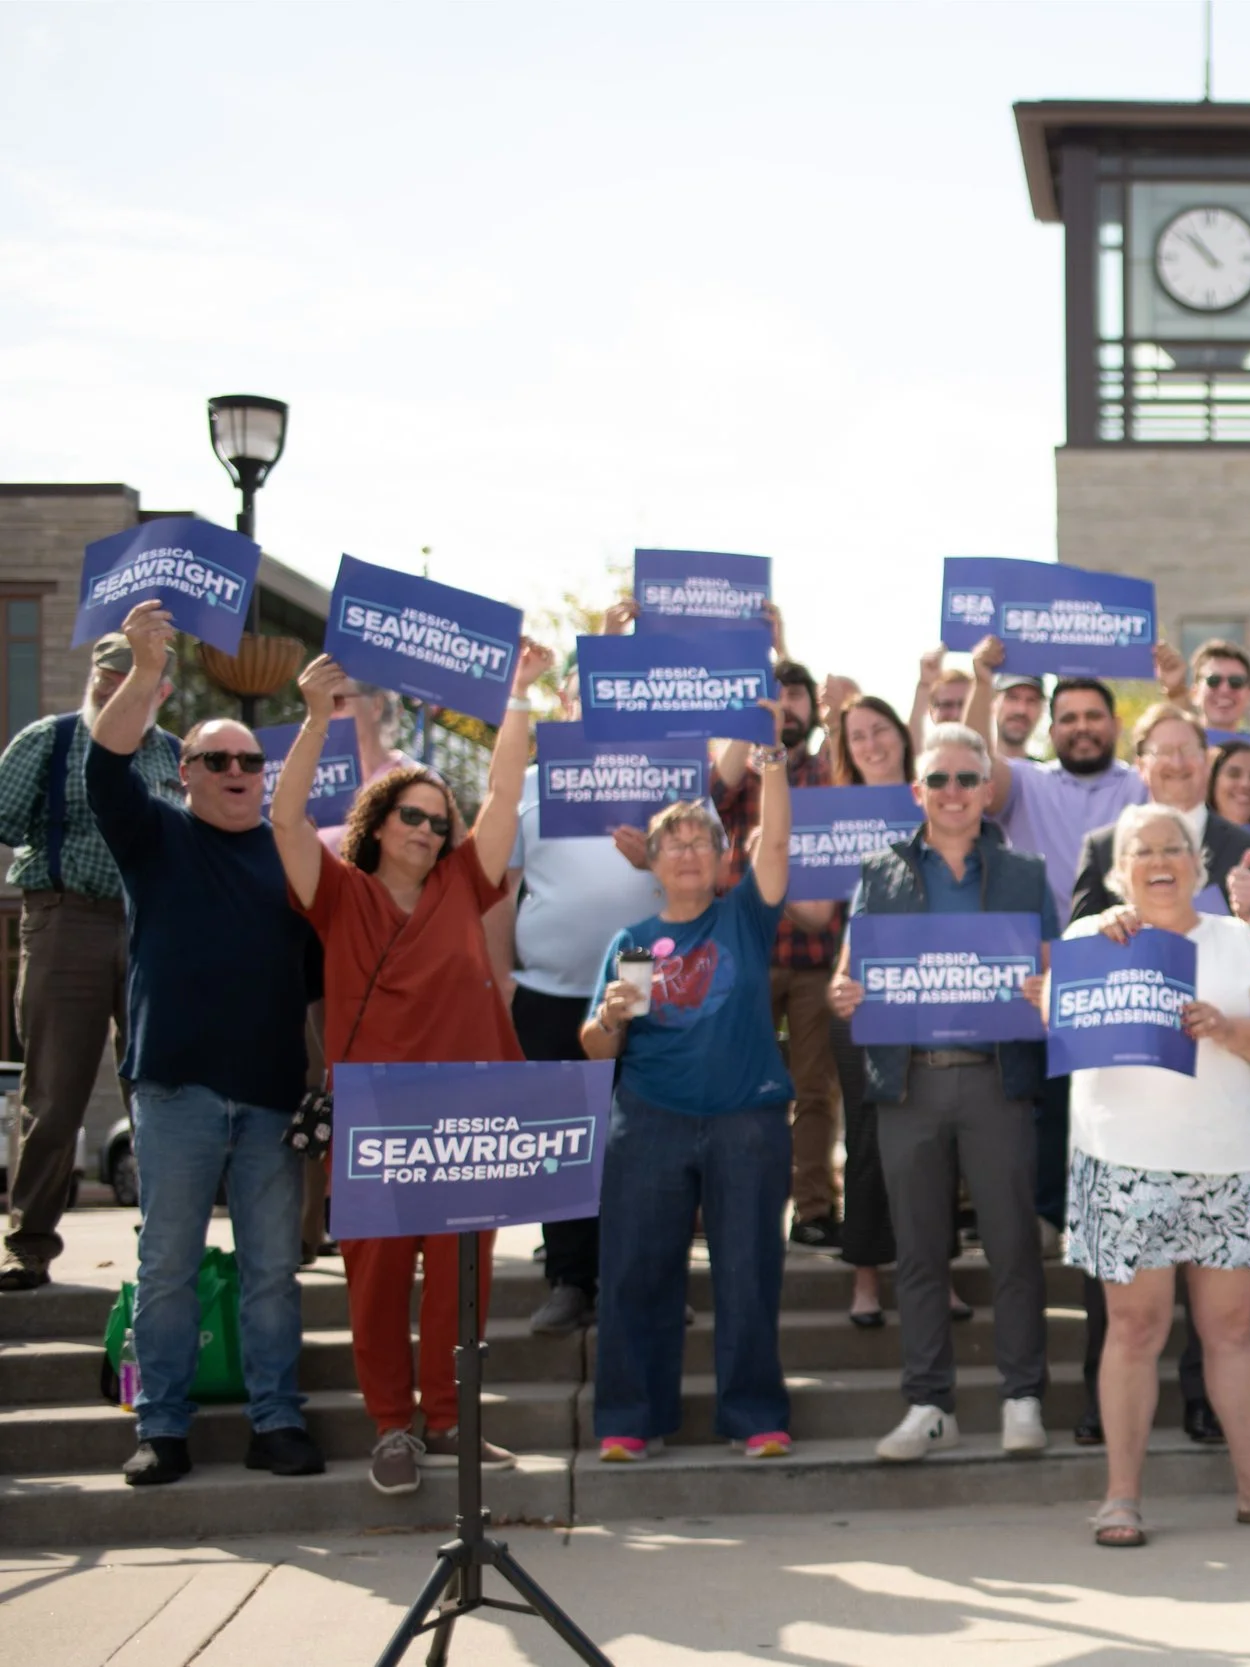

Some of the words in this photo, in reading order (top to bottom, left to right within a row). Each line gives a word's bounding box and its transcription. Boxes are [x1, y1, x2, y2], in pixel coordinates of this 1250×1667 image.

[134, 547, 195, 565] JESSICA
[92, 558, 240, 601] SEAWRIGHT
[685, 576, 731, 589] JESSICA
[103, 585, 128, 605] FOR
[130, 575, 206, 599] ASSEMBLY
[645, 585, 765, 611] SEAWRIGHT
[1052, 600, 1103, 614] JESSICA
[401, 607, 461, 634] JESSICA
[1005, 609, 1146, 636] SEAWRIGHT
[346, 605, 507, 670] SEAWRIGHT
[1021, 631, 1049, 643] FOR
[1051, 631, 1115, 646] ASSEMBLY
[362, 630, 395, 649] FOR
[395, 641, 471, 674] ASSEMBLY
[648, 666, 709, 681] JESSICA
[596, 677, 761, 701] SEAWRIGHT
[616, 699, 648, 712] FOR
[651, 698, 729, 712] ASSEMBLY
[593, 754, 650, 768] JESSICA
[550, 767, 697, 790] SEAWRIGHT
[566, 789, 592, 802] FOR
[594, 788, 666, 802] ASSEMBLY
[832, 819, 887, 833] JESSICA
[803, 854, 830, 867] FOR
[919, 952, 979, 967] JESSICA
[867, 965, 1030, 990] SEAWRIGHT
[1106, 968, 1165, 985] JESSICA
[885, 989, 917, 1004] FOR
[919, 988, 997, 1004] ASSEMBLY
[1073, 1012, 1102, 1029] FOR
[1103, 1008, 1176, 1027] ASSEMBLY
[433, 1116, 520, 1135] JESSICA
[357, 1127, 588, 1168] SEAWRIGHT
[383, 1167, 427, 1184] FOR
[432, 1160, 541, 1183] ASSEMBLY
